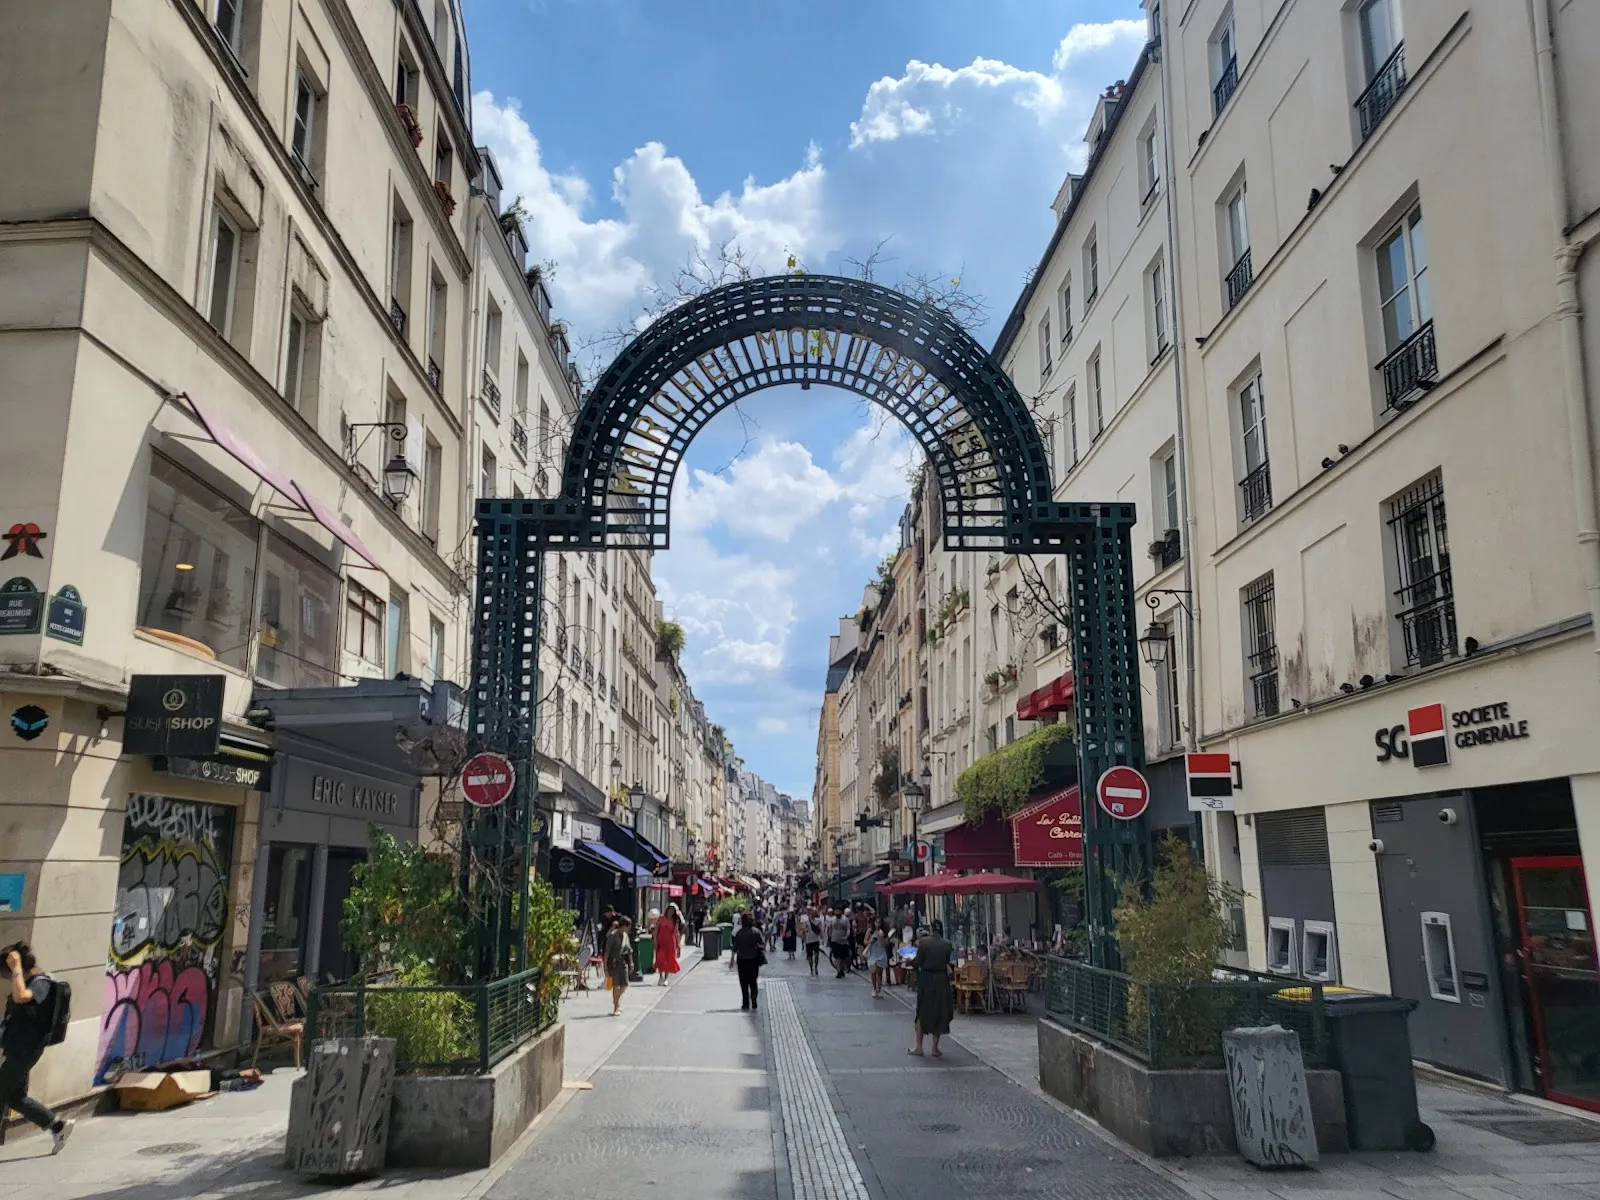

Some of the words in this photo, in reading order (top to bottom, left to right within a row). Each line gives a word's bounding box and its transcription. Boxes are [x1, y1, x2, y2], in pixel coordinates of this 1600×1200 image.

[754, 326, 999, 498] MONTORGUEIL
[1451, 701, 1510, 729] SOCIETE
[1374, 723, 1409, 763] SG
[1454, 719, 1530, 749] GENERALE
[312, 775, 346, 806] ERIC
[352, 784, 398, 814] KAYSER
[1049, 826, 1082, 839] Carre
[1058, 812, 1082, 825] Petit
[1068, 851, 1084, 859] Bras
